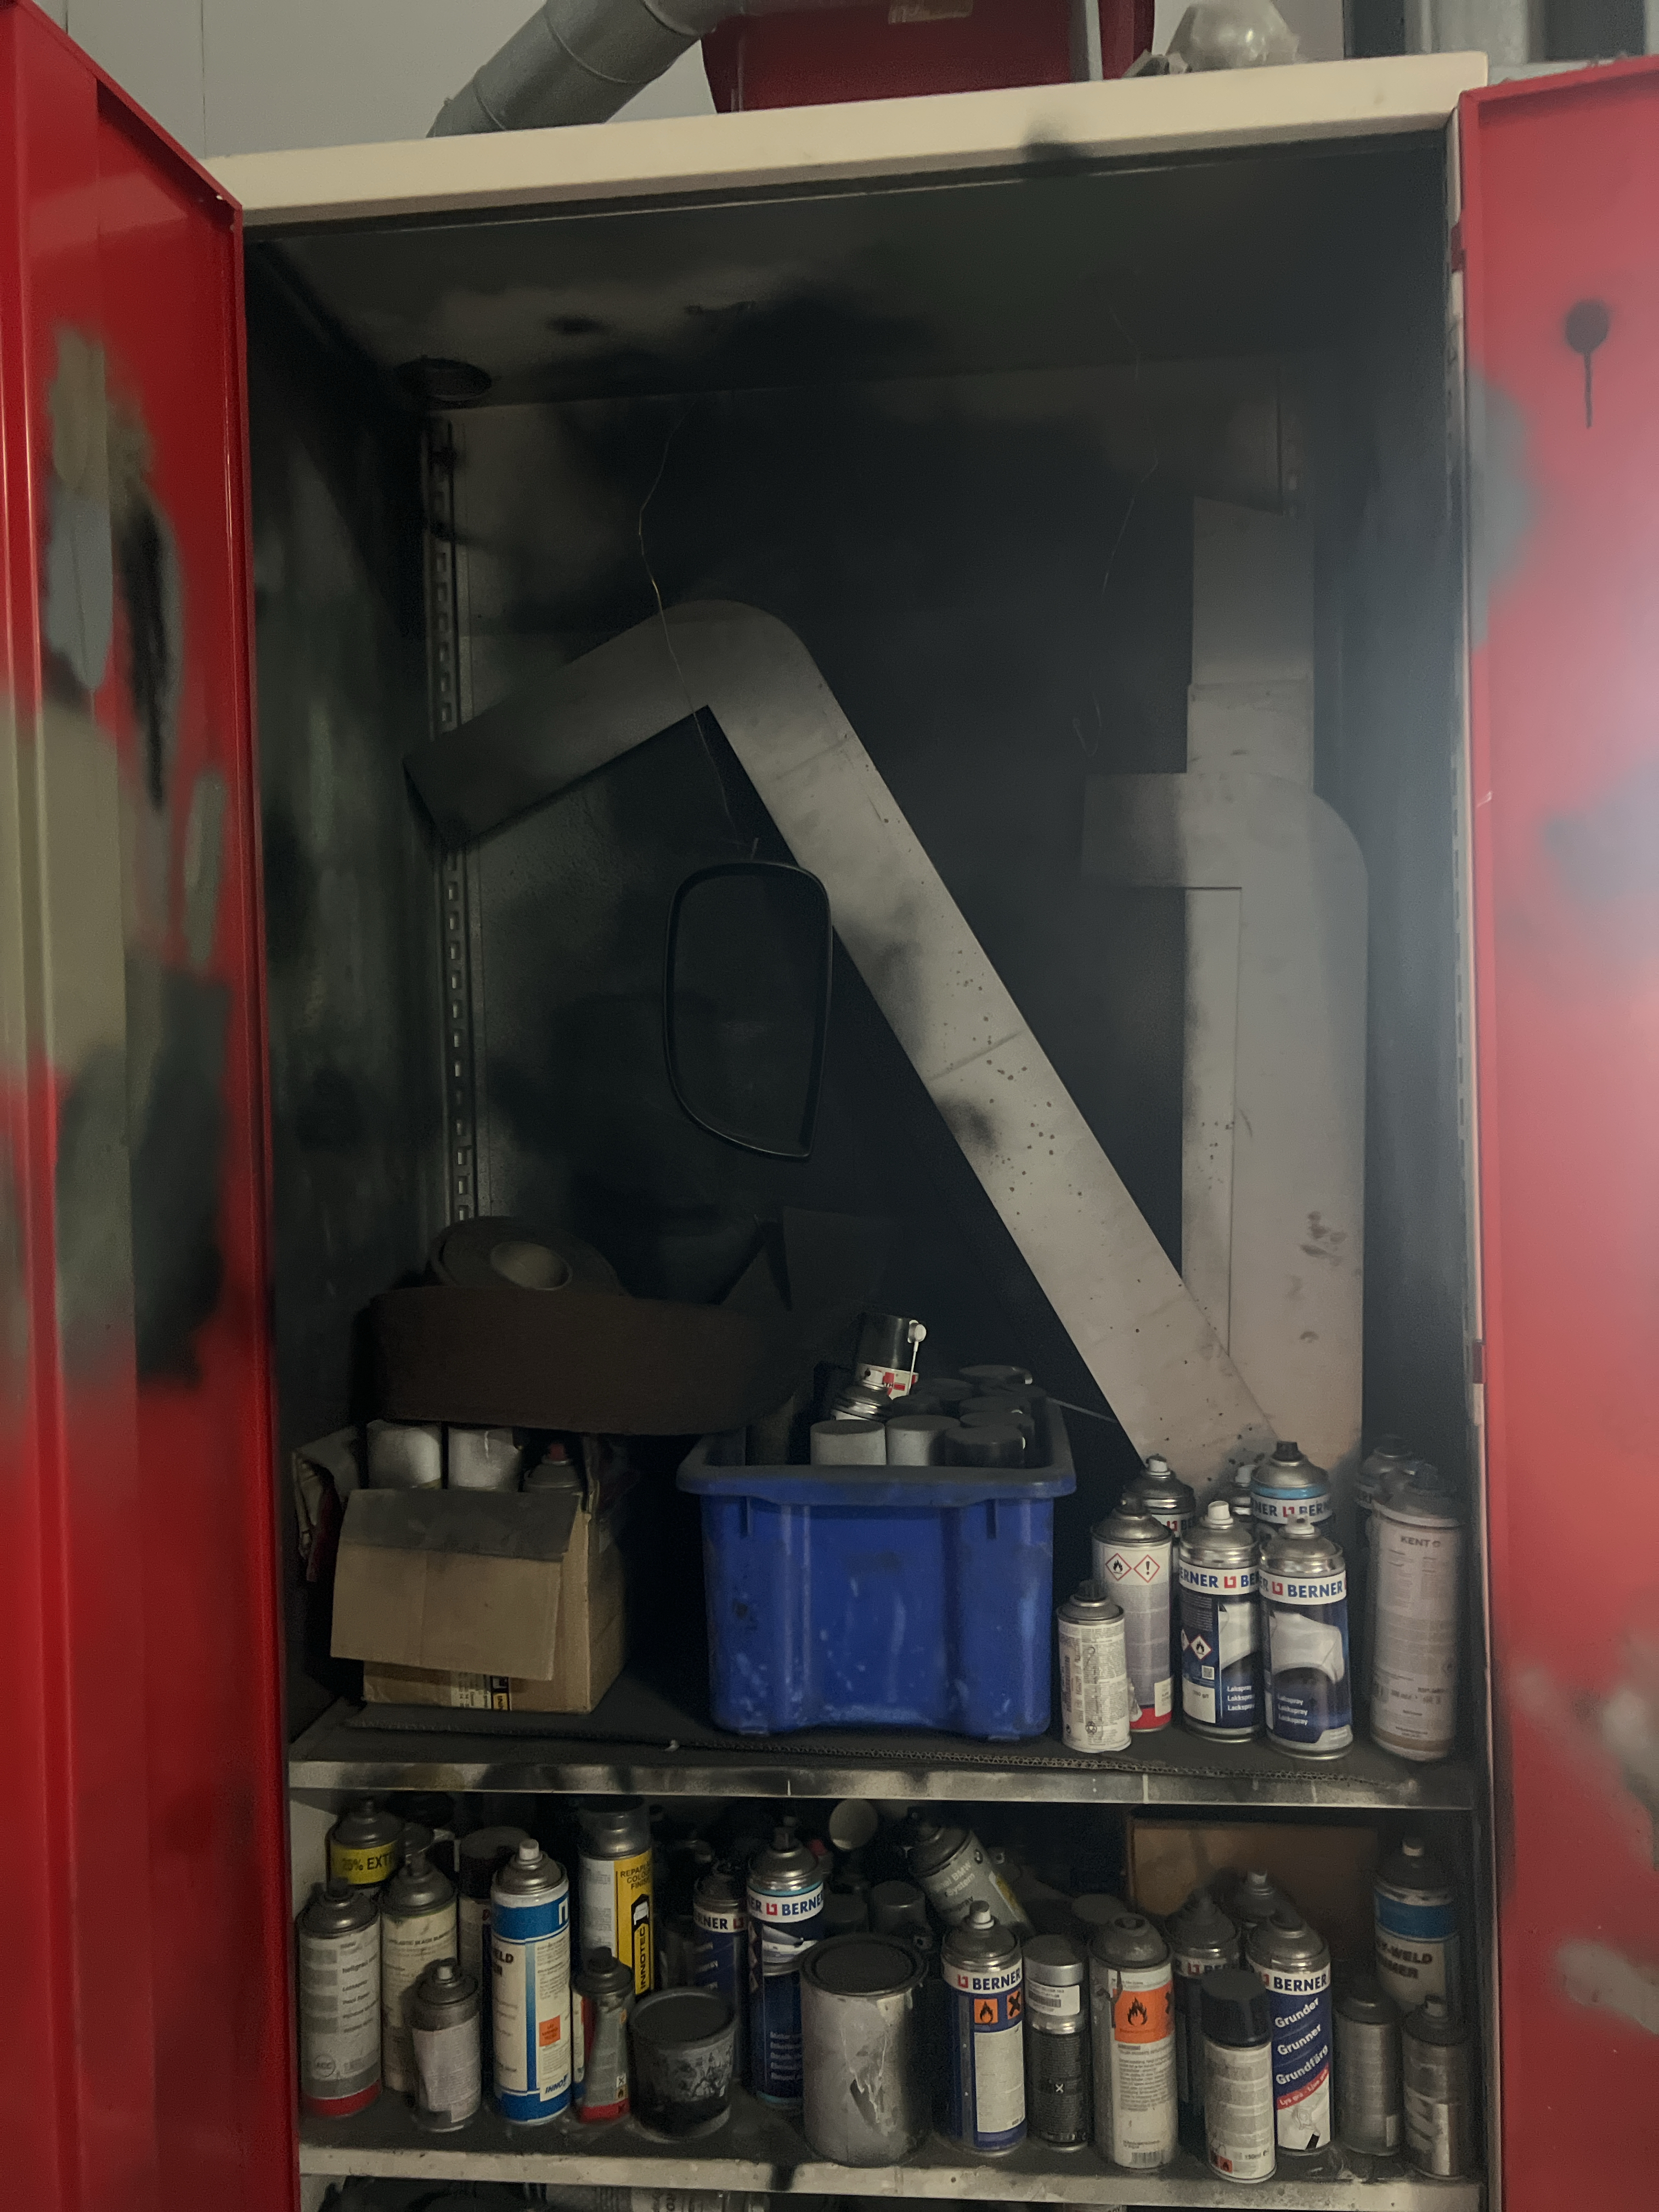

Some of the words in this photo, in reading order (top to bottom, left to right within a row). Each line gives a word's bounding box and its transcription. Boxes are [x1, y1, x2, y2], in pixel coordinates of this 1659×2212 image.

[1401, 1536, 1431, 1548] KENT
[1288, 1581, 1342, 1598] BERNER
[951, 1859, 972, 1881] BMW
[972, 1967, 1022, 1990] BERNER
[1273, 1974, 1327, 1991] BERNER
[1274, 1997, 1319, 2028] Grunder
[1277, 2024, 1322, 2055] Grunner
